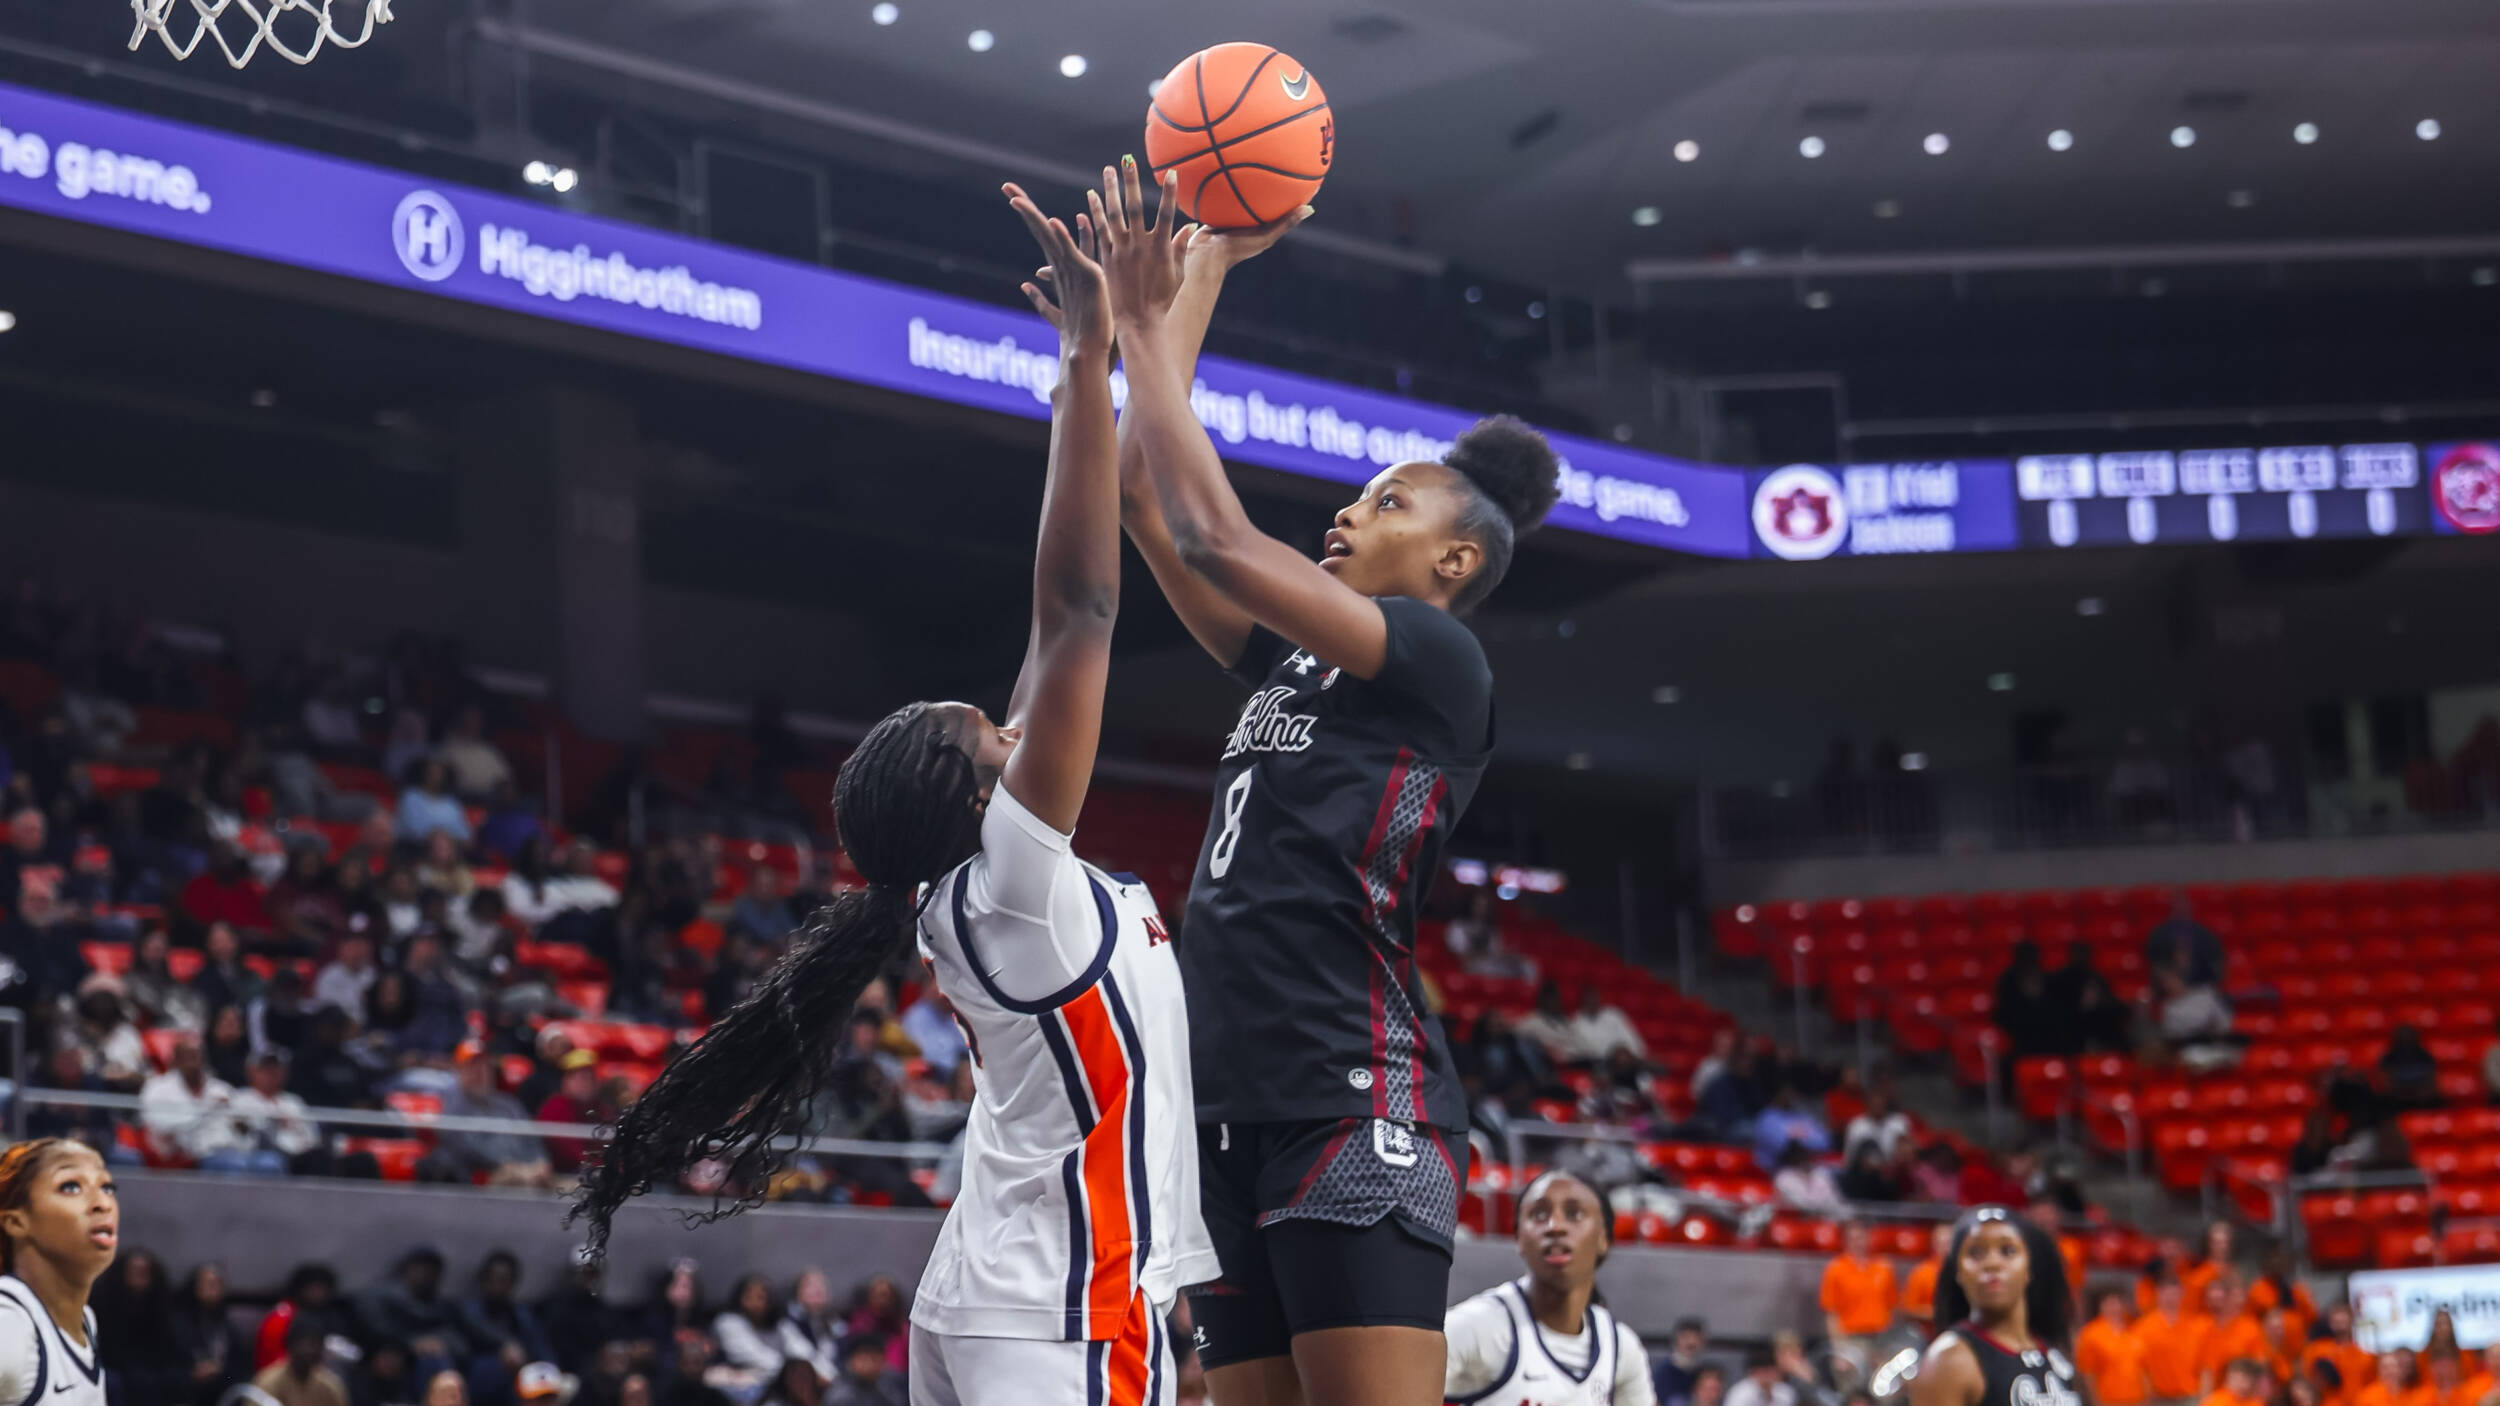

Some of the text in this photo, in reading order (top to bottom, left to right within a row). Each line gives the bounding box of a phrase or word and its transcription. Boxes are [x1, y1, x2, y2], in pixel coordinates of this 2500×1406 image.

[55, 141, 212, 214] game.
[479, 222, 762, 330] Higginbotham
[908, 316, 1060, 405] Insuring
[1247, 389, 1307, 447] but
[1307, 405, 1367, 460] the
[1594, 474, 1690, 528] game.
[1209, 767, 1253, 880] 8
